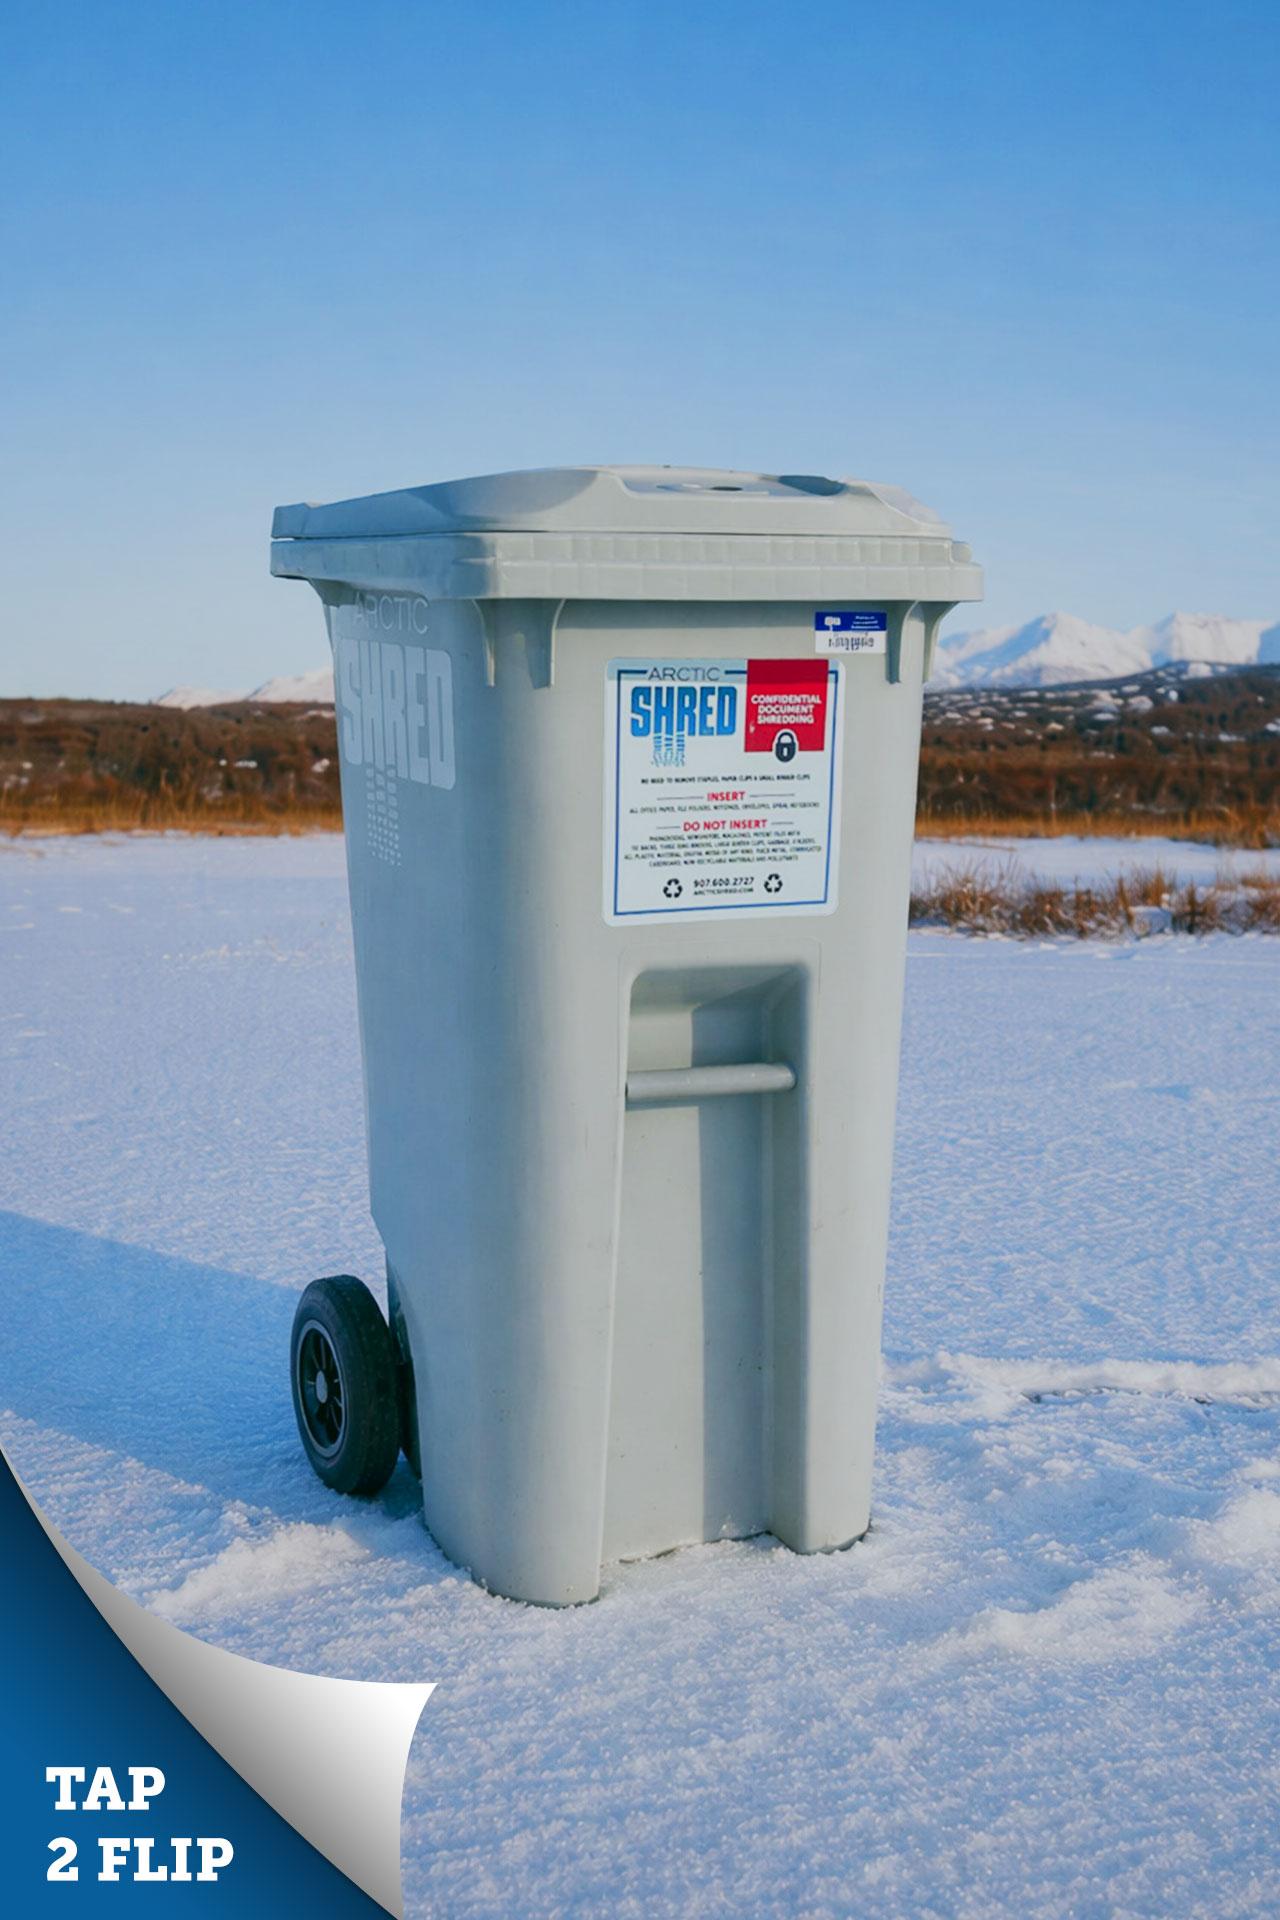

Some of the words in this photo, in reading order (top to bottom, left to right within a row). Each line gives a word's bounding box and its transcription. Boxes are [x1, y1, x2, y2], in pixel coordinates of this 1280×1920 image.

[353, 592, 430, 635] ARCTIC
[648, 667, 720, 681] ARCTIC
[750, 693, 822, 704] CONFIDENTIAL
[338, 637, 457, 791] SHRED
[630, 686, 737, 737] SHRED
[757, 703, 815, 714] DOCUMENT
[757, 714, 815, 725] SHREDDING
[706, 791, 746, 802] INSERT
[682, 821, 700, 832] DO
[703, 820, 726, 831] NOT
[729, 818, 768, 830] INSERT
[693, 876, 755, 888] 907.600.2727
